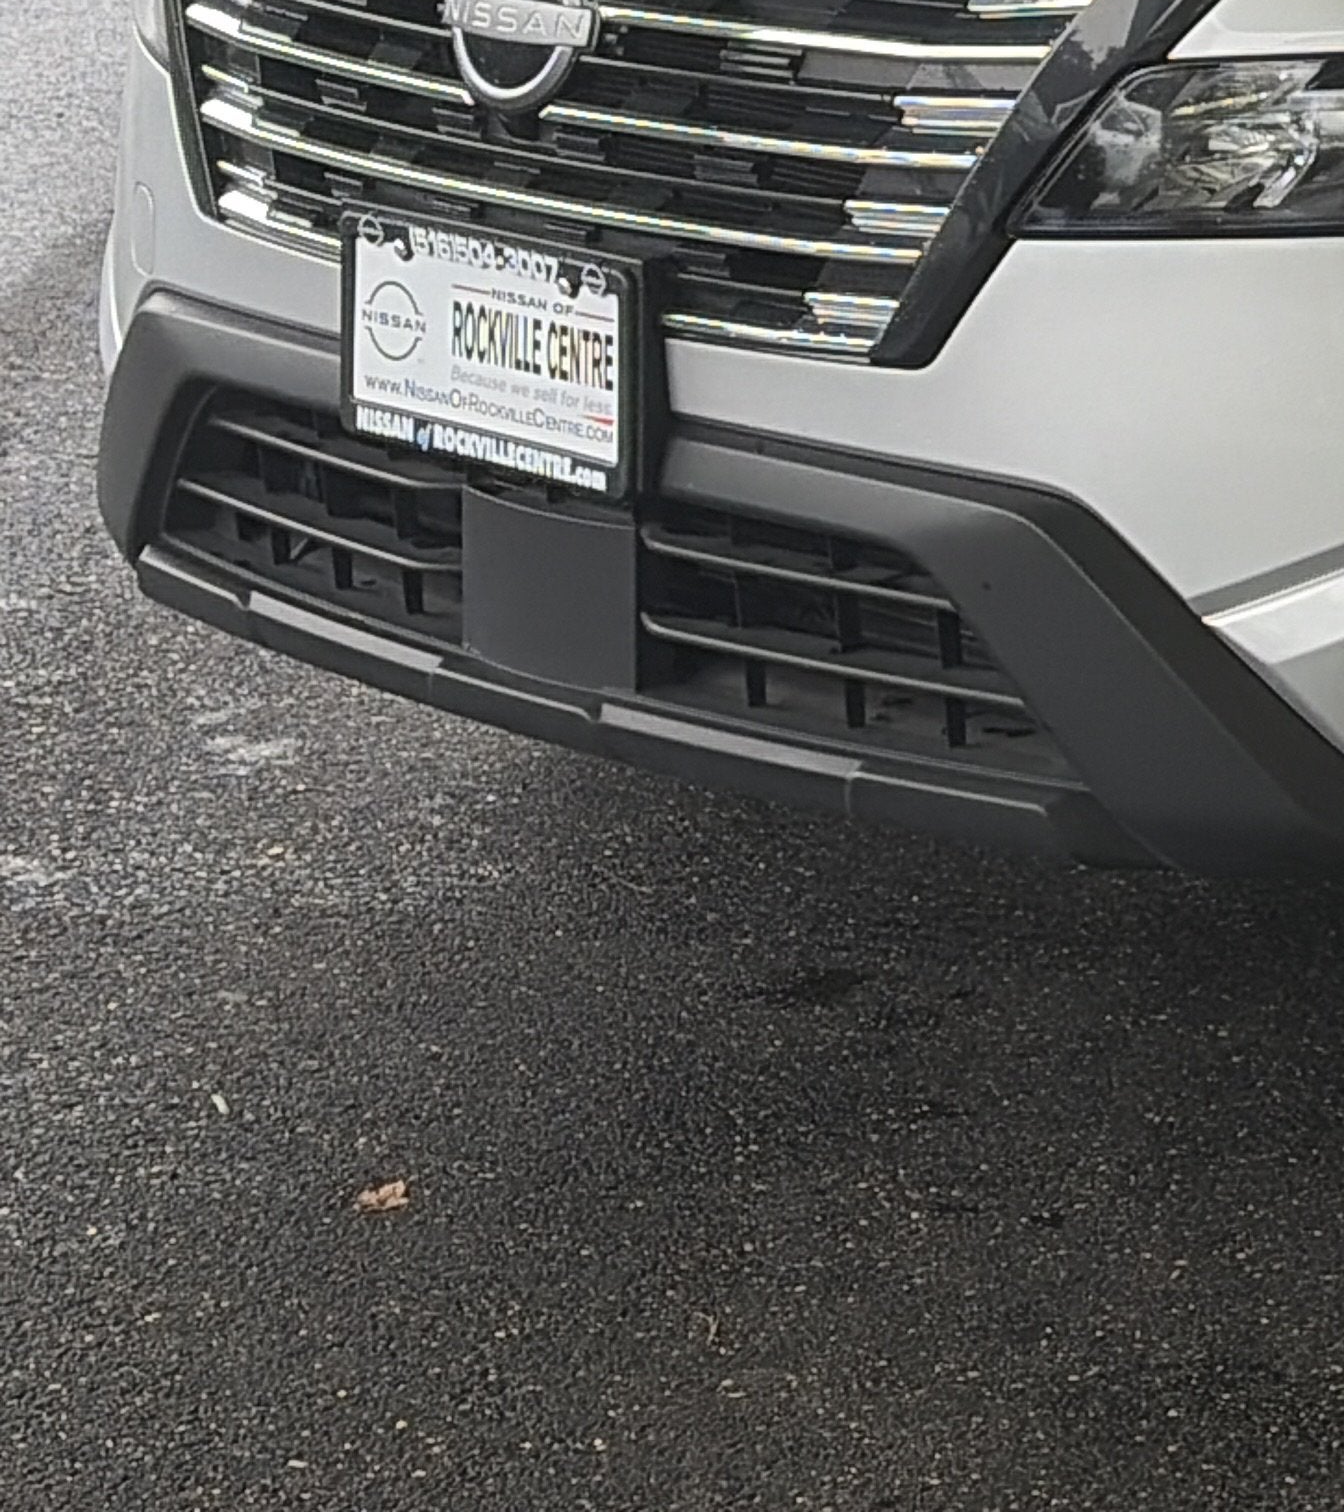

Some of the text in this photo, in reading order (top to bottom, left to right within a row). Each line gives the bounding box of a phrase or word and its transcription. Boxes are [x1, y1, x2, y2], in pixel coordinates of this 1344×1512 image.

[491, 287, 575, 316] NISSAN OF
[361, 308, 427, 335] NISSAN
[452, 299, 614, 391] ROCKVILLE CENTRE
[450, 365, 507, 391] Because
[511, 383, 530, 399] we
[533, 385, 558, 402] sell
[560, 388, 580, 409] for
[356, 404, 415, 442] NISSAN
